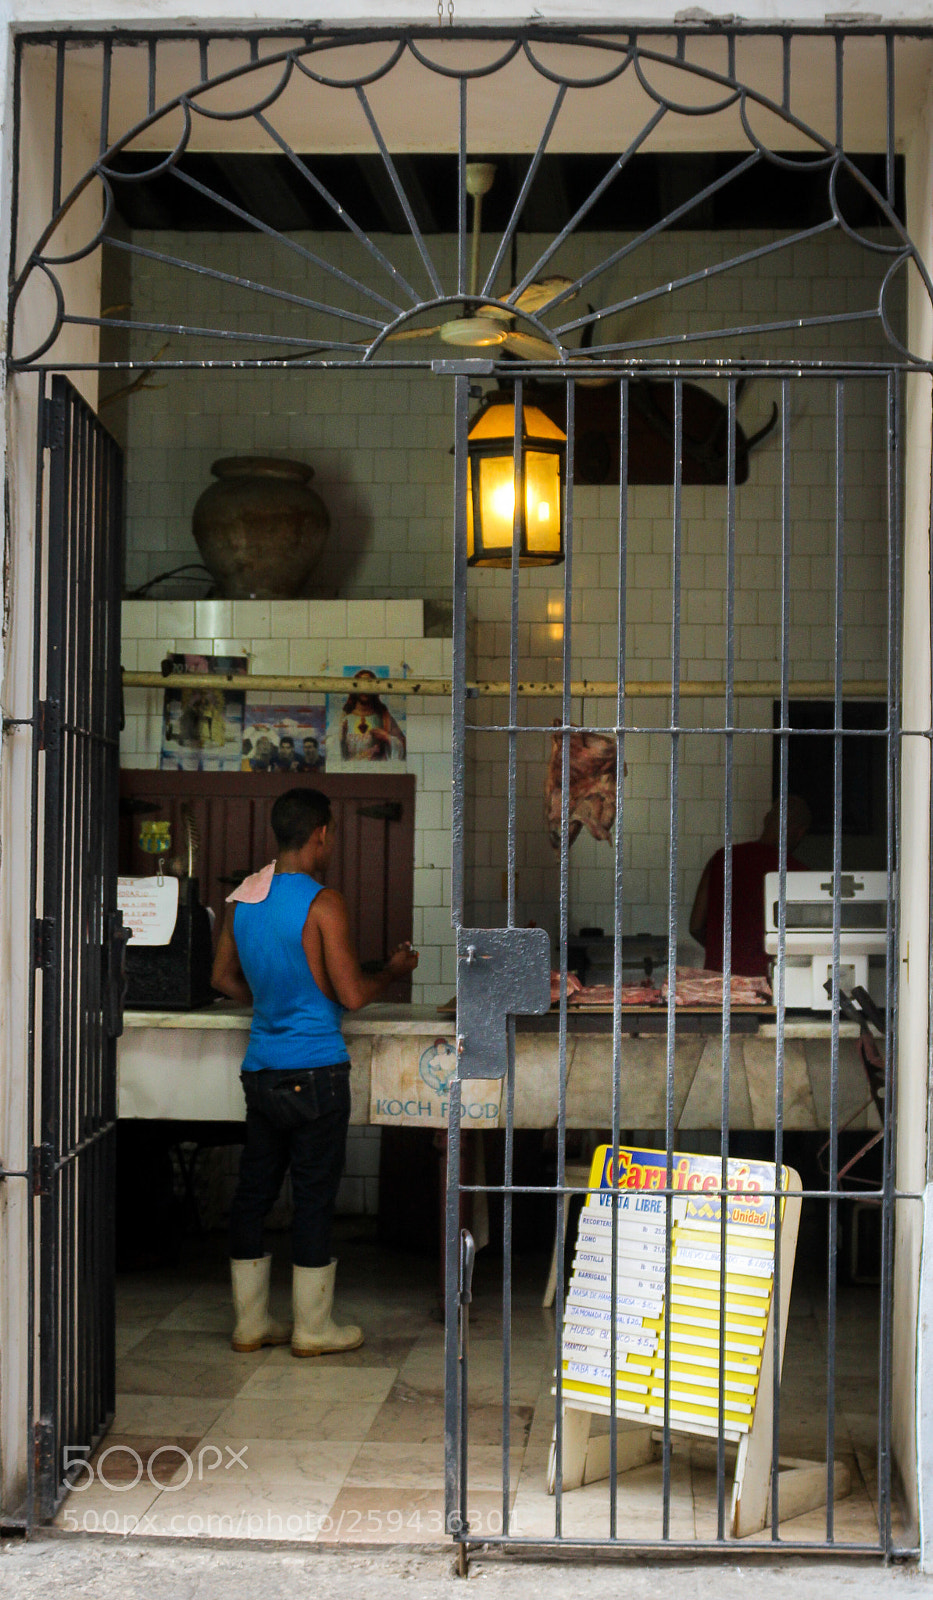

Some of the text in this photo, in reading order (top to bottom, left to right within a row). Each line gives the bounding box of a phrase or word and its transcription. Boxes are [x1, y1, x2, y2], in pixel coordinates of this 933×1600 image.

[376, 1100, 432, 1116] KOCH
[607, 1152, 762, 1204] Carnicería
[600, 1192, 630, 1210] VETA
[731, 1208, 767, 1226] Unidad
[581, 1235, 597, 1243] LOMO
[579, 1253, 605, 1263] COSTILLA
[577, 1271, 608, 1282] BARRIGADA
[572, 1288, 589, 1298] MASA
[589, 1290, 599, 1300] DE
[571, 1307, 603, 1319] JAMONADA
[570, 1324, 596, 1337] HUESO
[600, 1330, 631, 1344] BLCO
[563, 1341, 588, 1352] MANTECA
[571, 1362, 589, 1375] JABA
